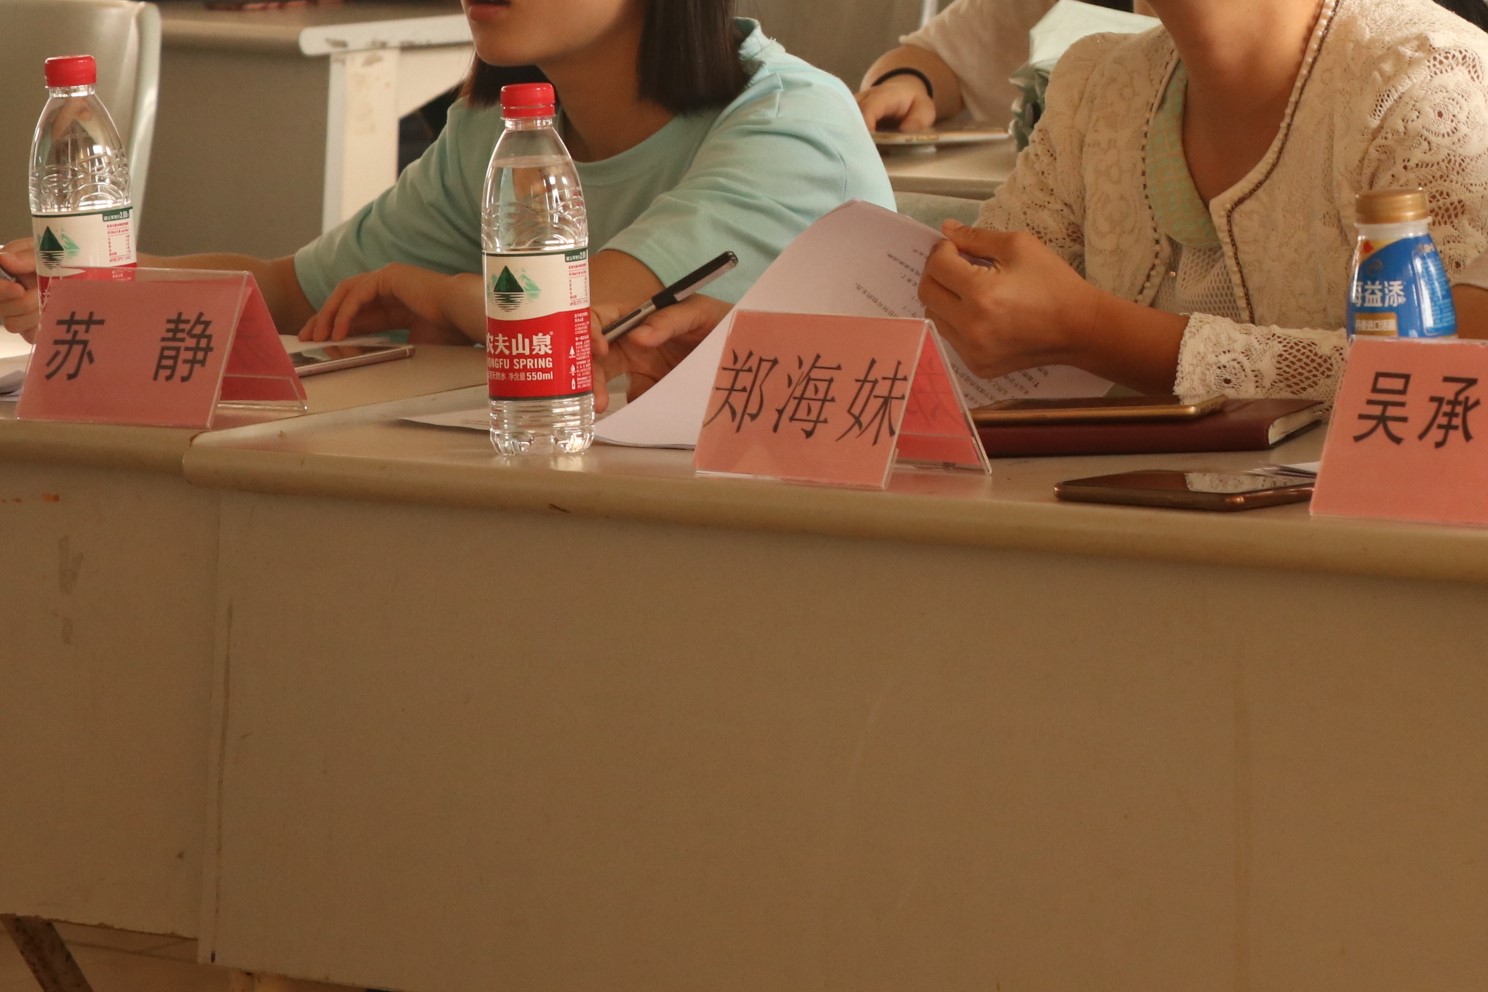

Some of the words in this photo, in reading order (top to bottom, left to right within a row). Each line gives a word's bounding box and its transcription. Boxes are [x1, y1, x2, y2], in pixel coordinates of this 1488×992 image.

[45, 310, 106, 382] 苏
[153, 311, 214, 383] 静
[513, 357, 553, 369] SPRING
[703, 349, 908, 446] 郑海妹
